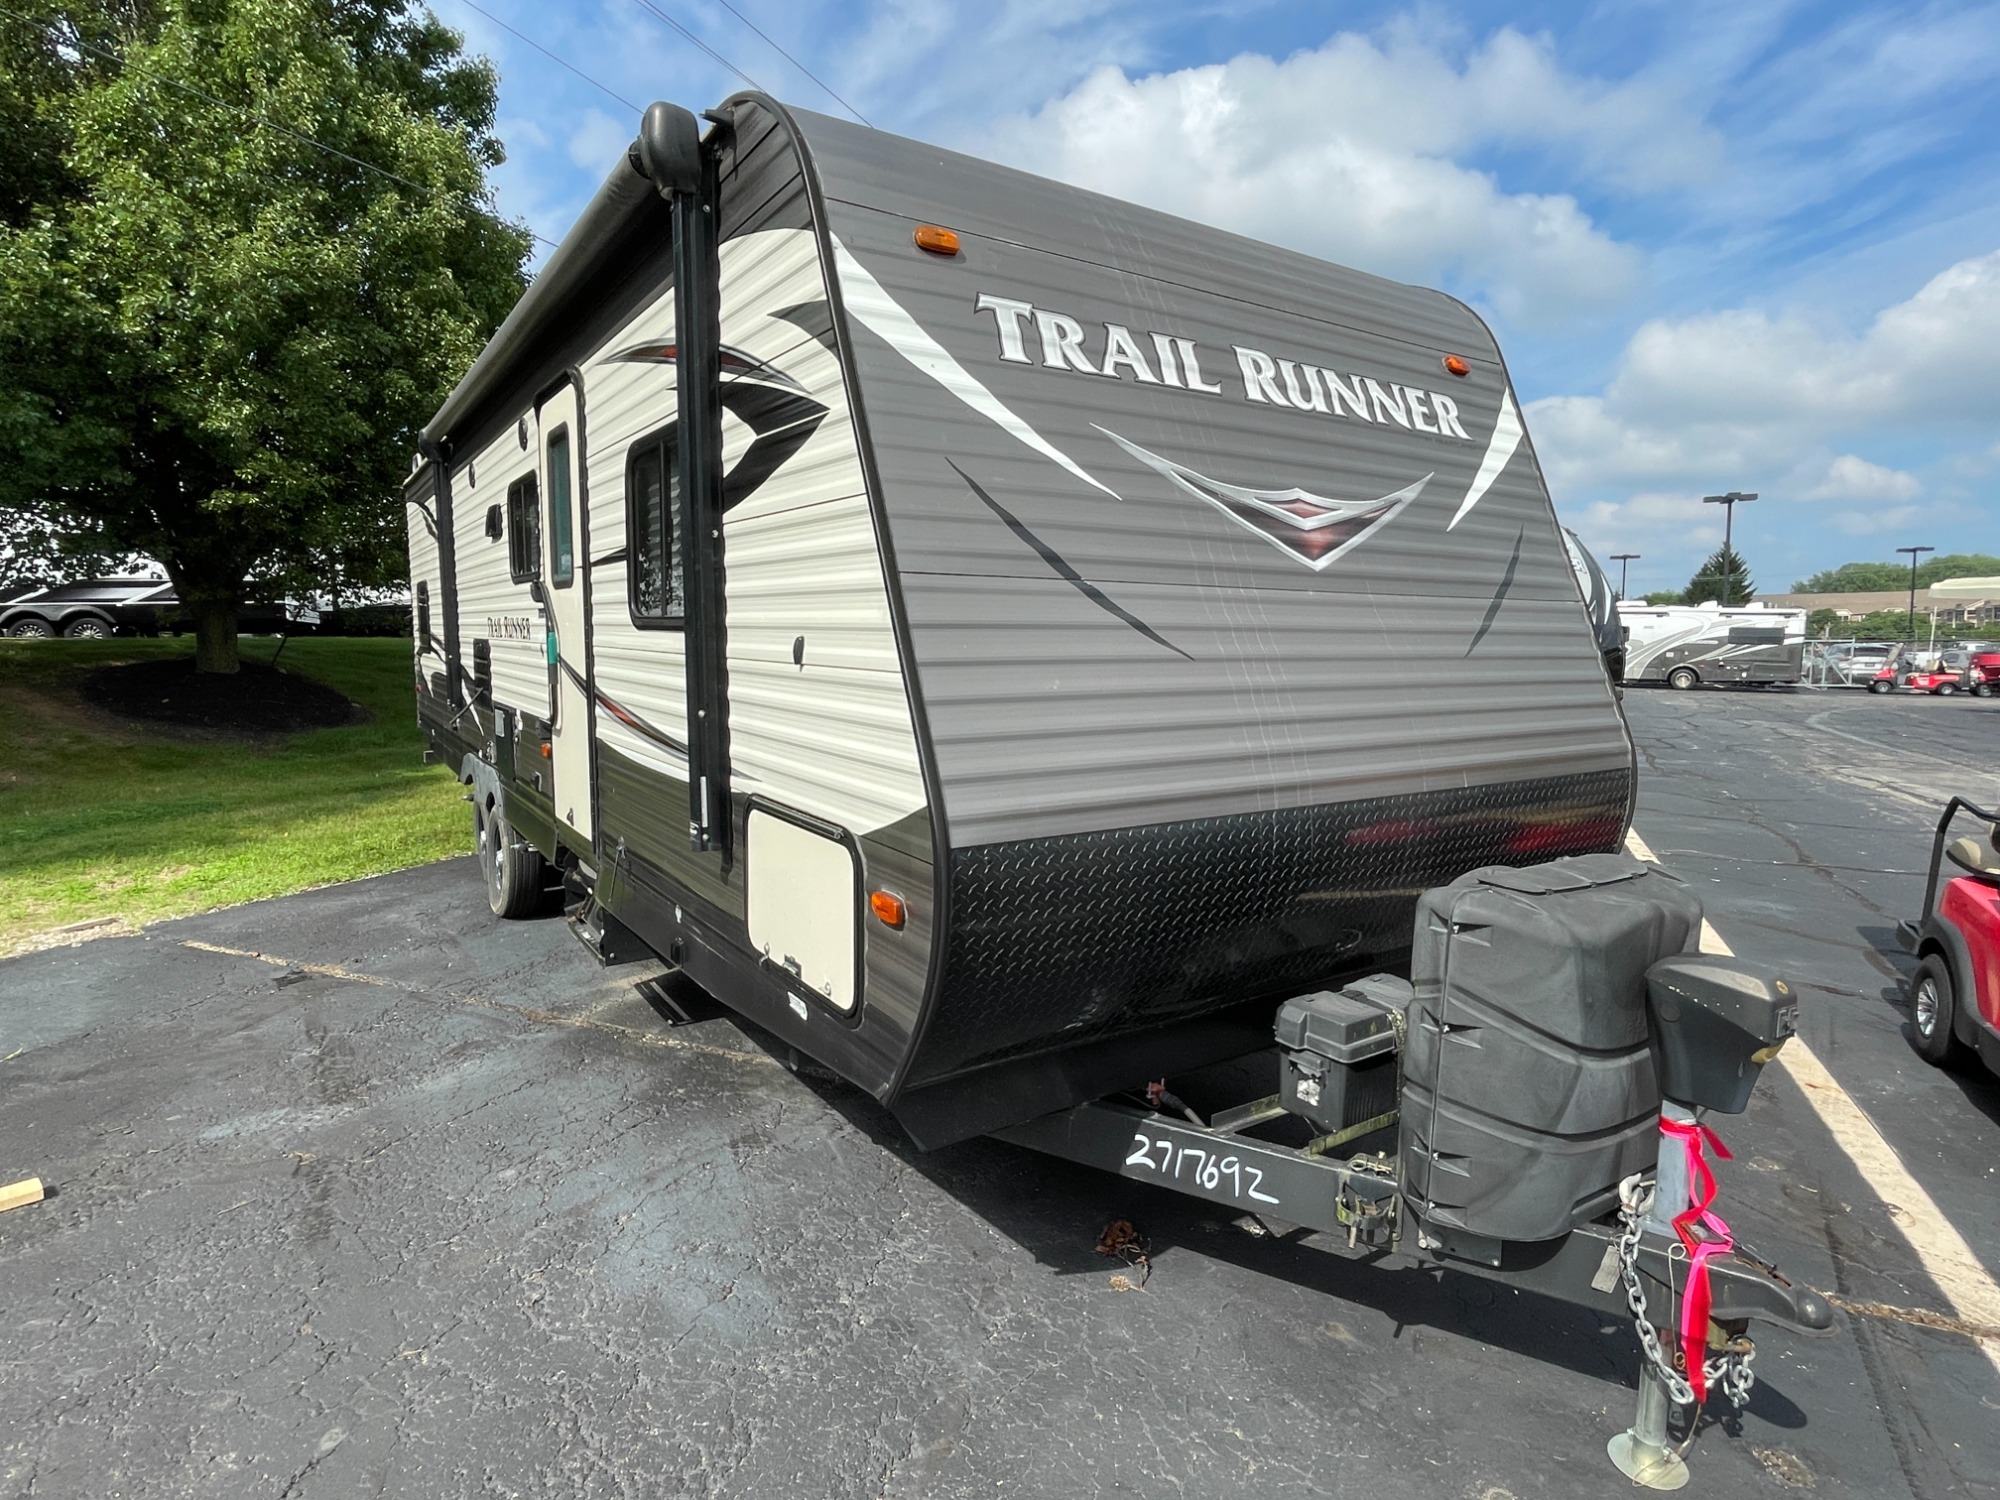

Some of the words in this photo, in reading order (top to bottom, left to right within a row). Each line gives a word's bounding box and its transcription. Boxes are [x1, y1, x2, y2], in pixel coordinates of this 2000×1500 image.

[975, 291, 1222, 395] TRAIL
[1230, 344, 1474, 441] RUNNER
[487, 616, 503, 638] TRAIL
[503, 616, 531, 640] RUNNER
[1125, 1133, 1280, 1204] 2717692
